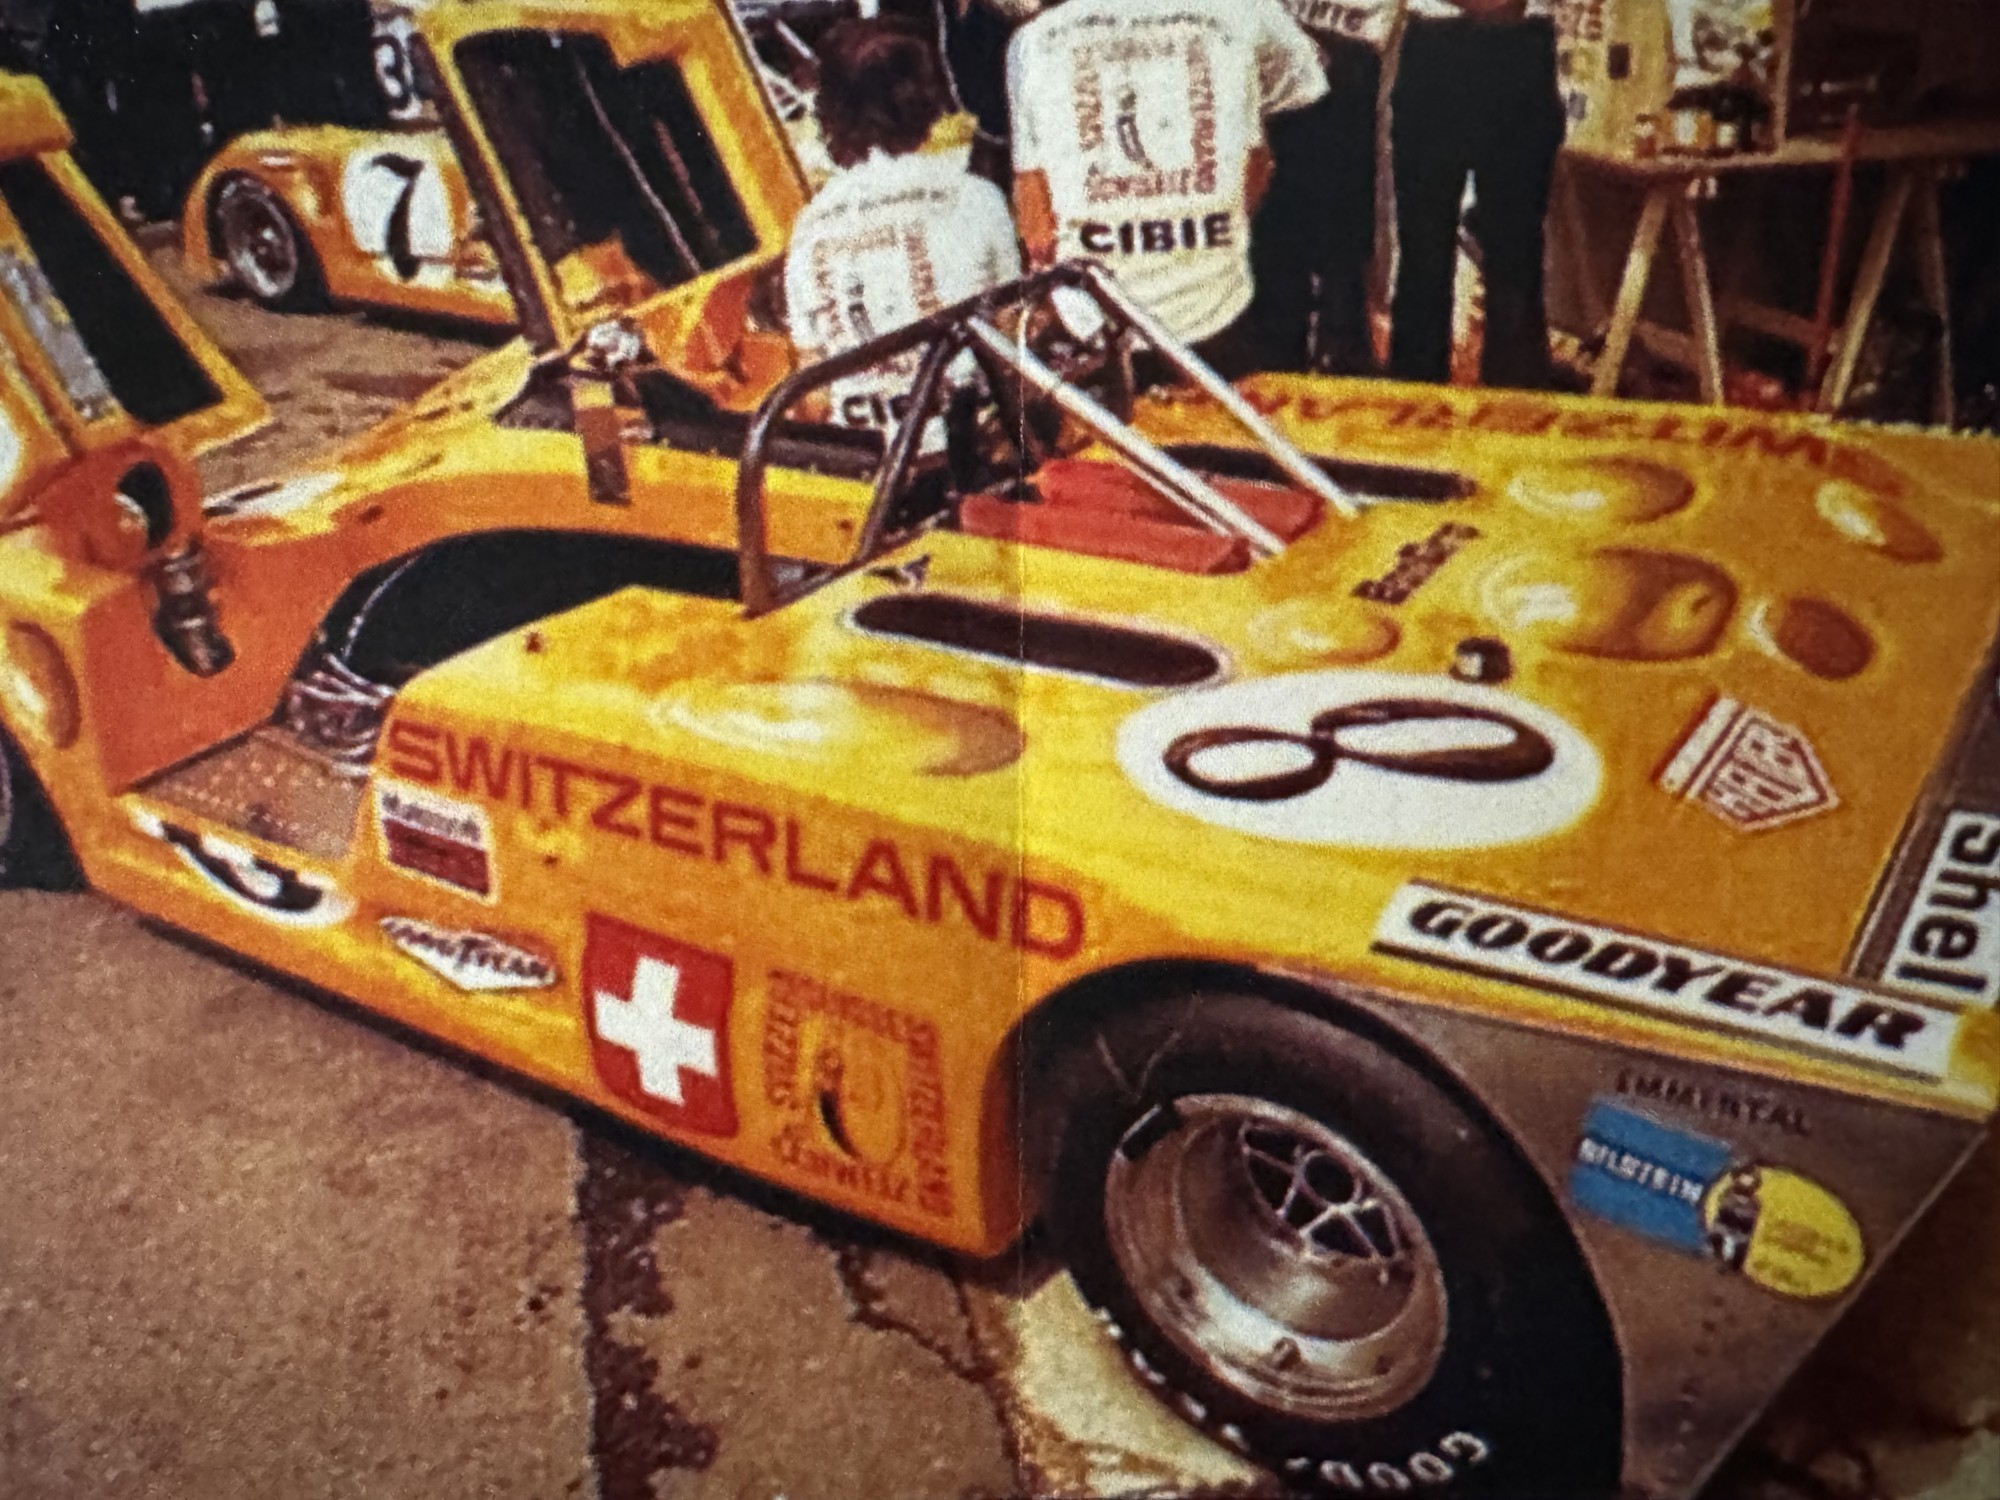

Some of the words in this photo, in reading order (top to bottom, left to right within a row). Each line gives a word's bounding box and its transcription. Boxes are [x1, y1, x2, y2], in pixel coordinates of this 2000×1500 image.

[371, 152, 424, 281] 7
[1080, 212, 1233, 254] CIBIE
[1163, 699, 1556, 803] 8
[387, 718, 1086, 960] SWITZERLAND
[1406, 899, 1926, 1050] GOODYEAR
